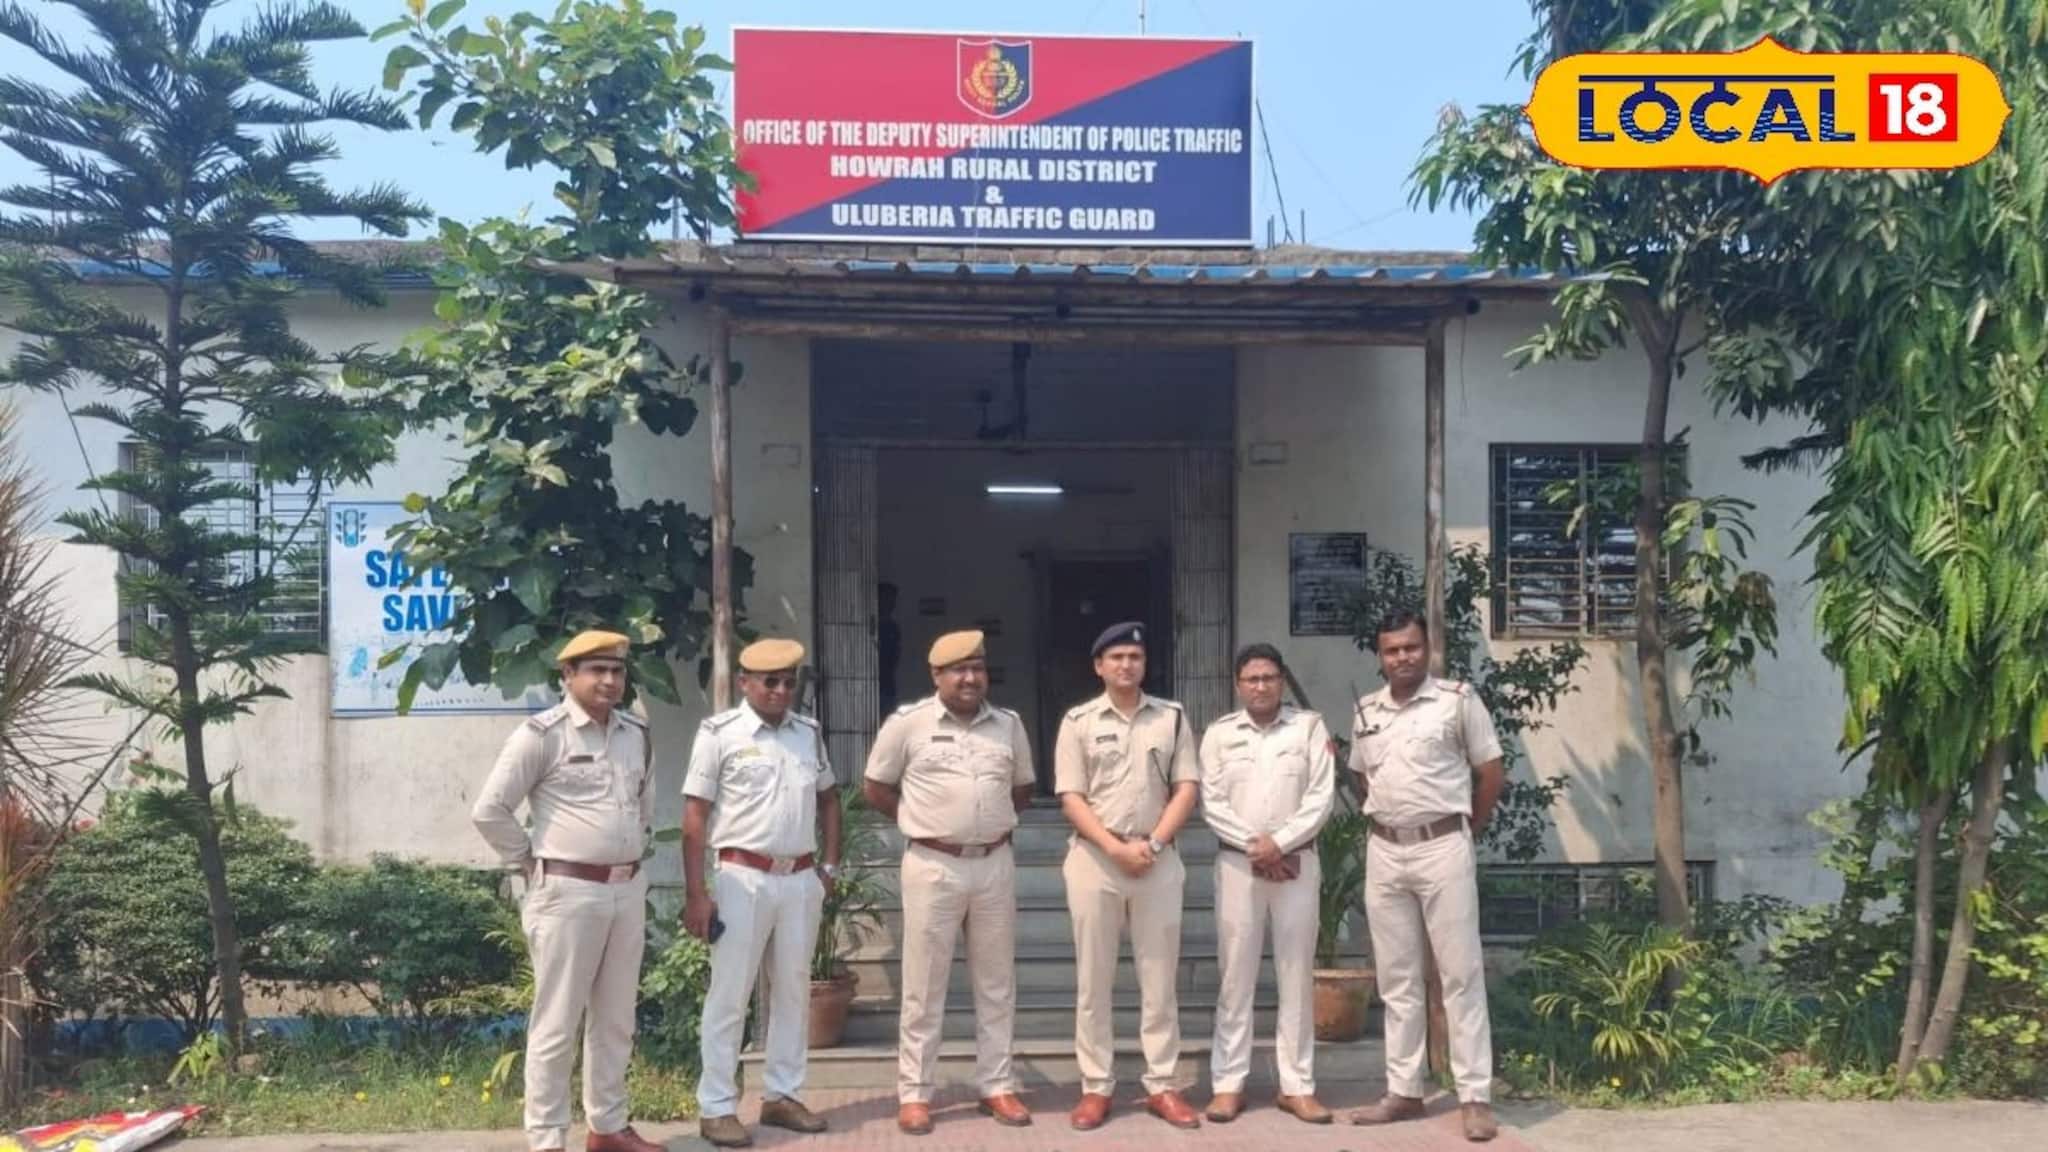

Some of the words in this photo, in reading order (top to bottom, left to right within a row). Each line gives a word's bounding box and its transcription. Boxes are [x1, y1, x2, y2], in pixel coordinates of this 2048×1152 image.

[743, 119, 802, 145] OFFICE
[806, 120, 827, 146] OF
[830, 121, 863, 147] THE
[866, 122, 931, 148] DEPUTY
[936, 123, 1084, 151] SUPERINTENDENT
[1087, 126, 1109, 151] OF
[1112, 126, 1170, 152] POLICE
[1174, 127, 1242, 153] TRAFFIC
[830, 155, 945, 179] HOWRAH
[951, 158, 1033, 181] RURAL
[1038, 159, 1157, 183] DISTRICT
[985, 185, 1004, 204] &
[832, 204, 956, 228] ULUBERIA
[961, 206, 1063, 229] TRAFFIC
[1069, 208, 1156, 231] GUARD
[383, 594, 455, 632] SAV
